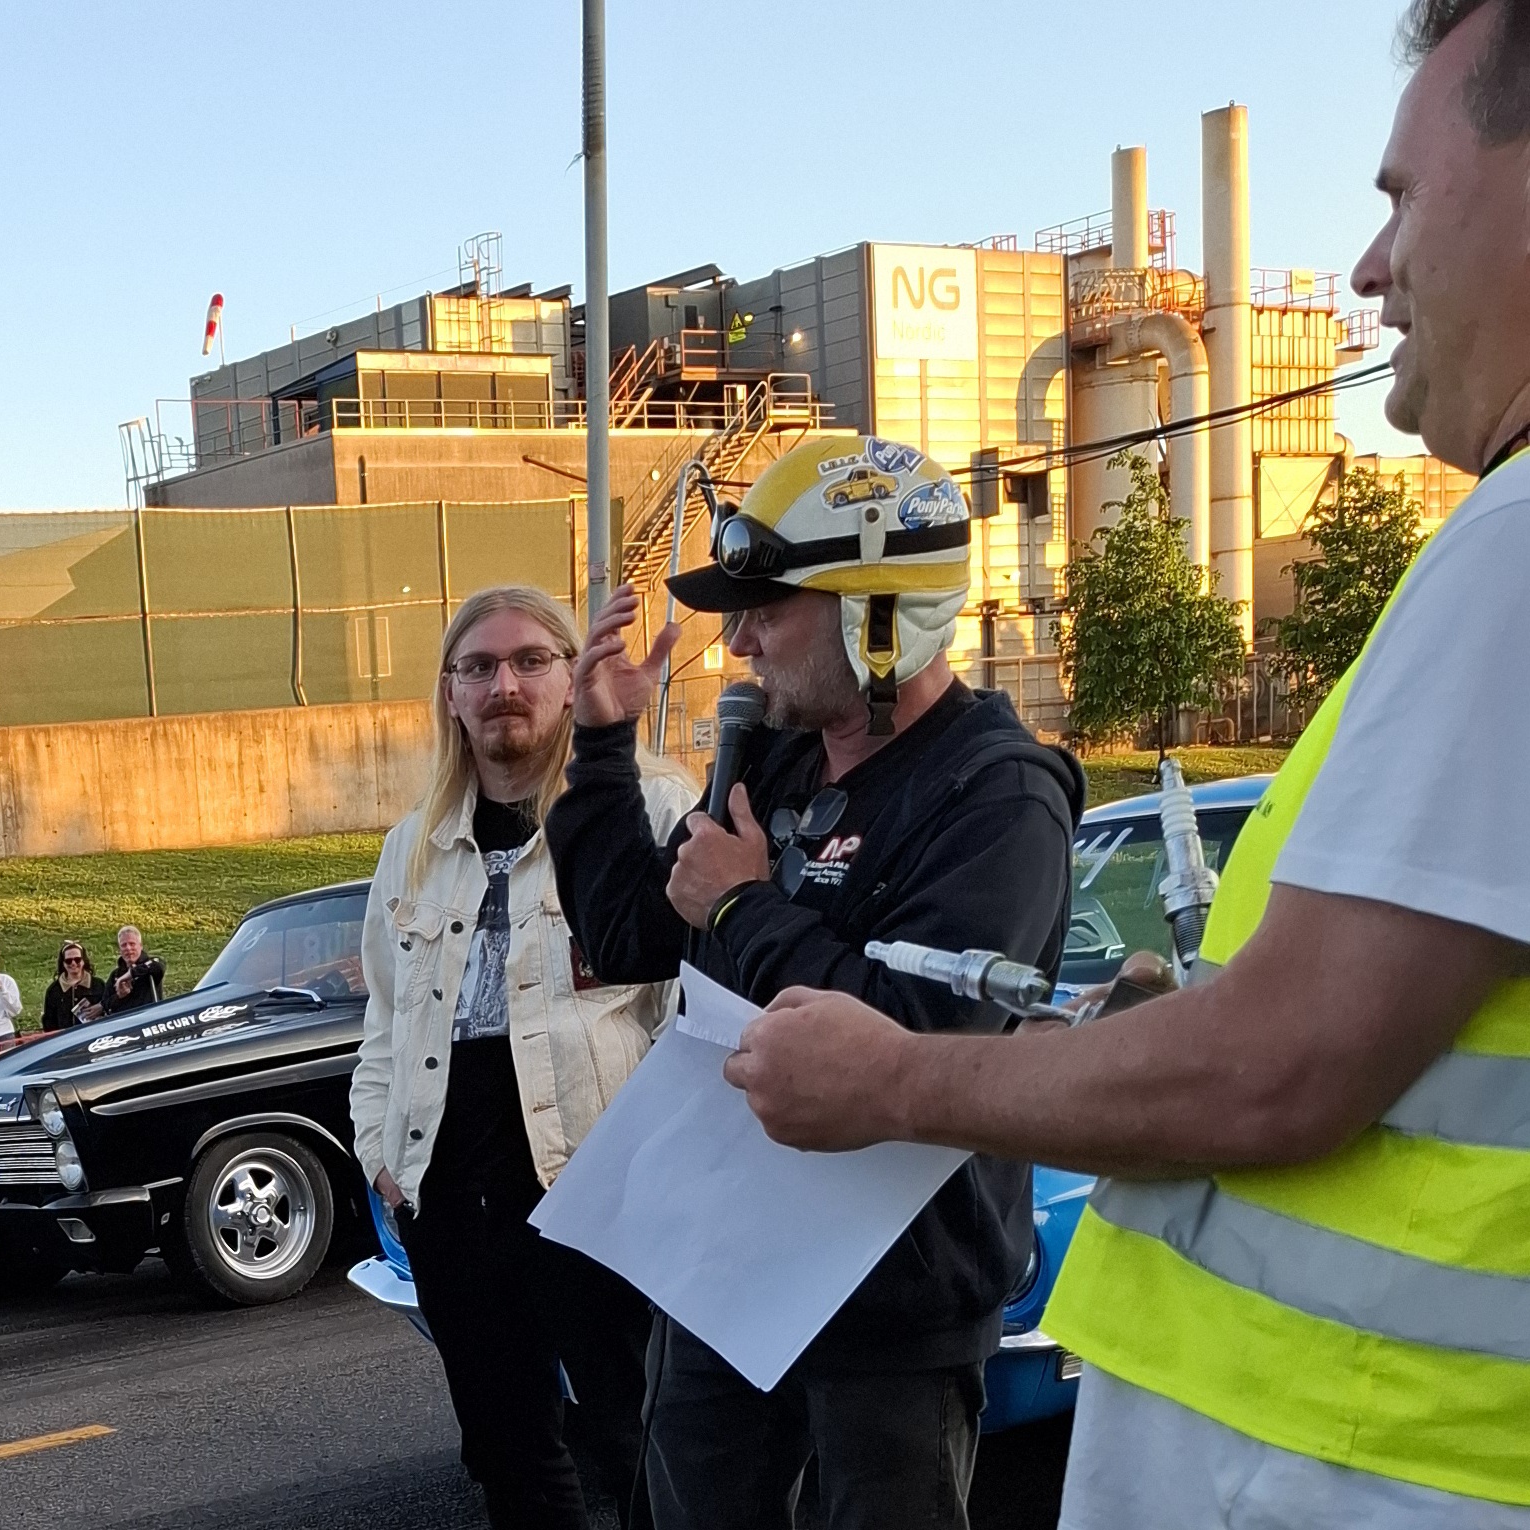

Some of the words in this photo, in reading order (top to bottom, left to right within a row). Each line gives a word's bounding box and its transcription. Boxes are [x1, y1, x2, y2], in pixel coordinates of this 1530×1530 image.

[892, 266, 960, 310] NG
[892, 320, 945, 341] Nordic
[141, 1014, 196, 1038] MERCURY
